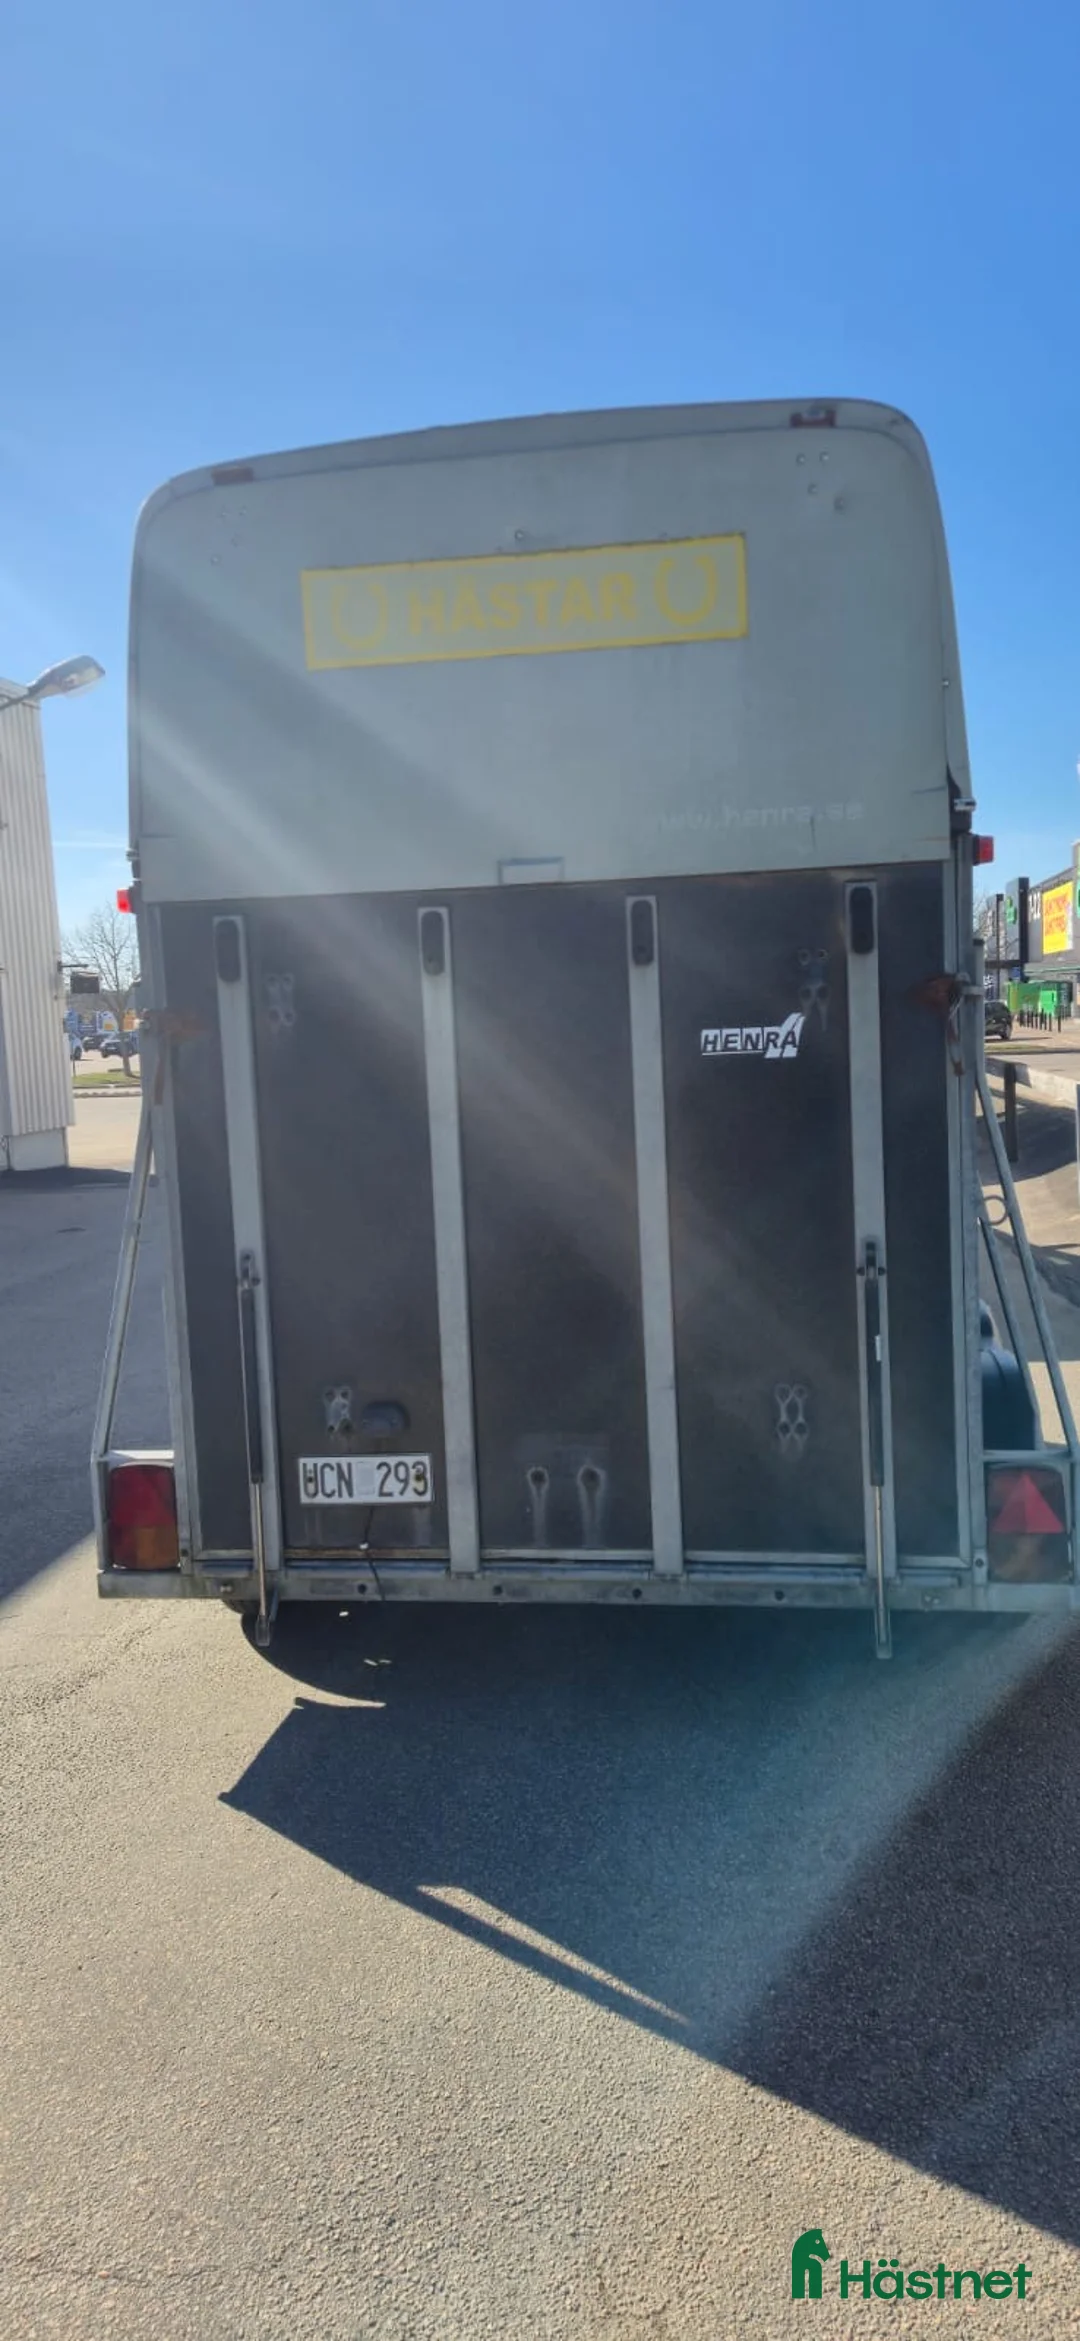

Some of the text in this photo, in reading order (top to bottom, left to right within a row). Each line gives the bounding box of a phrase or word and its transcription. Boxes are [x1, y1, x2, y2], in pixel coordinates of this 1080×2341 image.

[407, 572, 638, 637] HÄSTAR
[702, 1028, 799, 1052] HENRA
[302, 1461, 428, 1498] UCN 293
